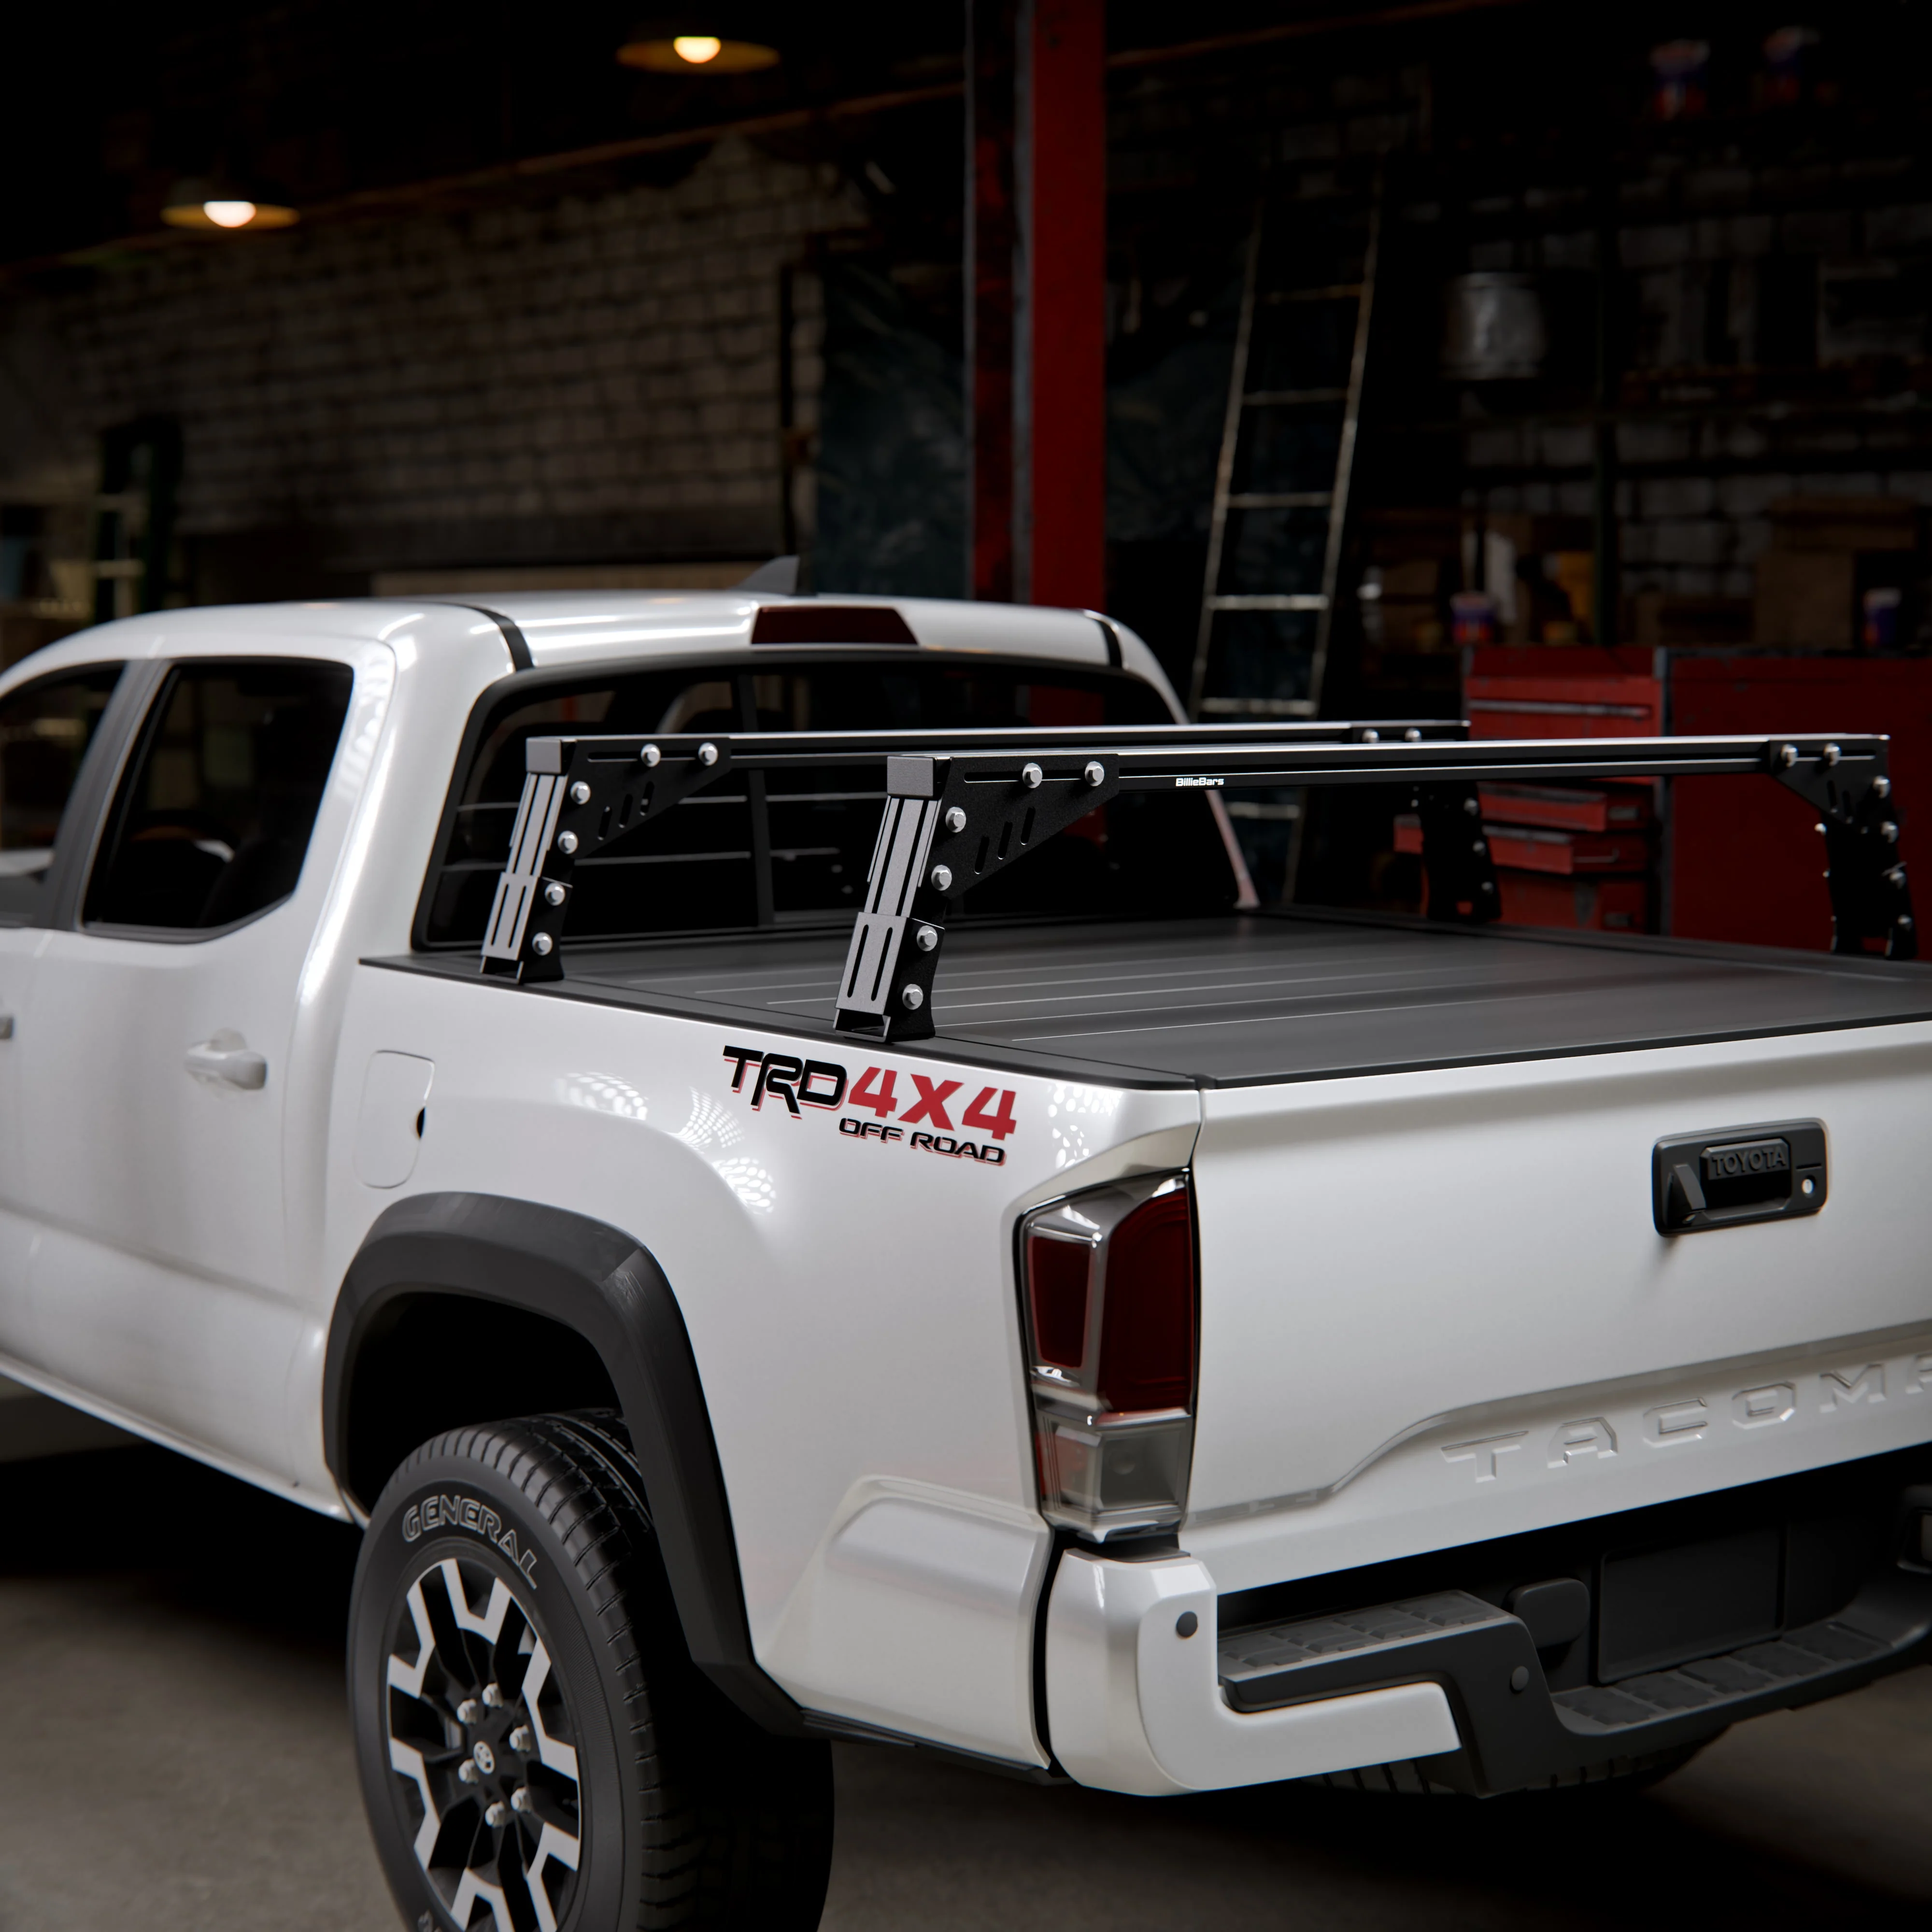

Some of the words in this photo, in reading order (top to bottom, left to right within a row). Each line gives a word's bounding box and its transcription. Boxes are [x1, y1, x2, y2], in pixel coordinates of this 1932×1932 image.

[1176, 777, 1224, 786] BillieBars
[723, 1045, 849, 1120] TRD
[839, 1118, 905, 1143] OFF
[910, 1132, 1007, 1166] ROAD
[1712, 1146, 1787, 1176] TOYOTA
[402, 1494, 538, 1590] GENERAL
